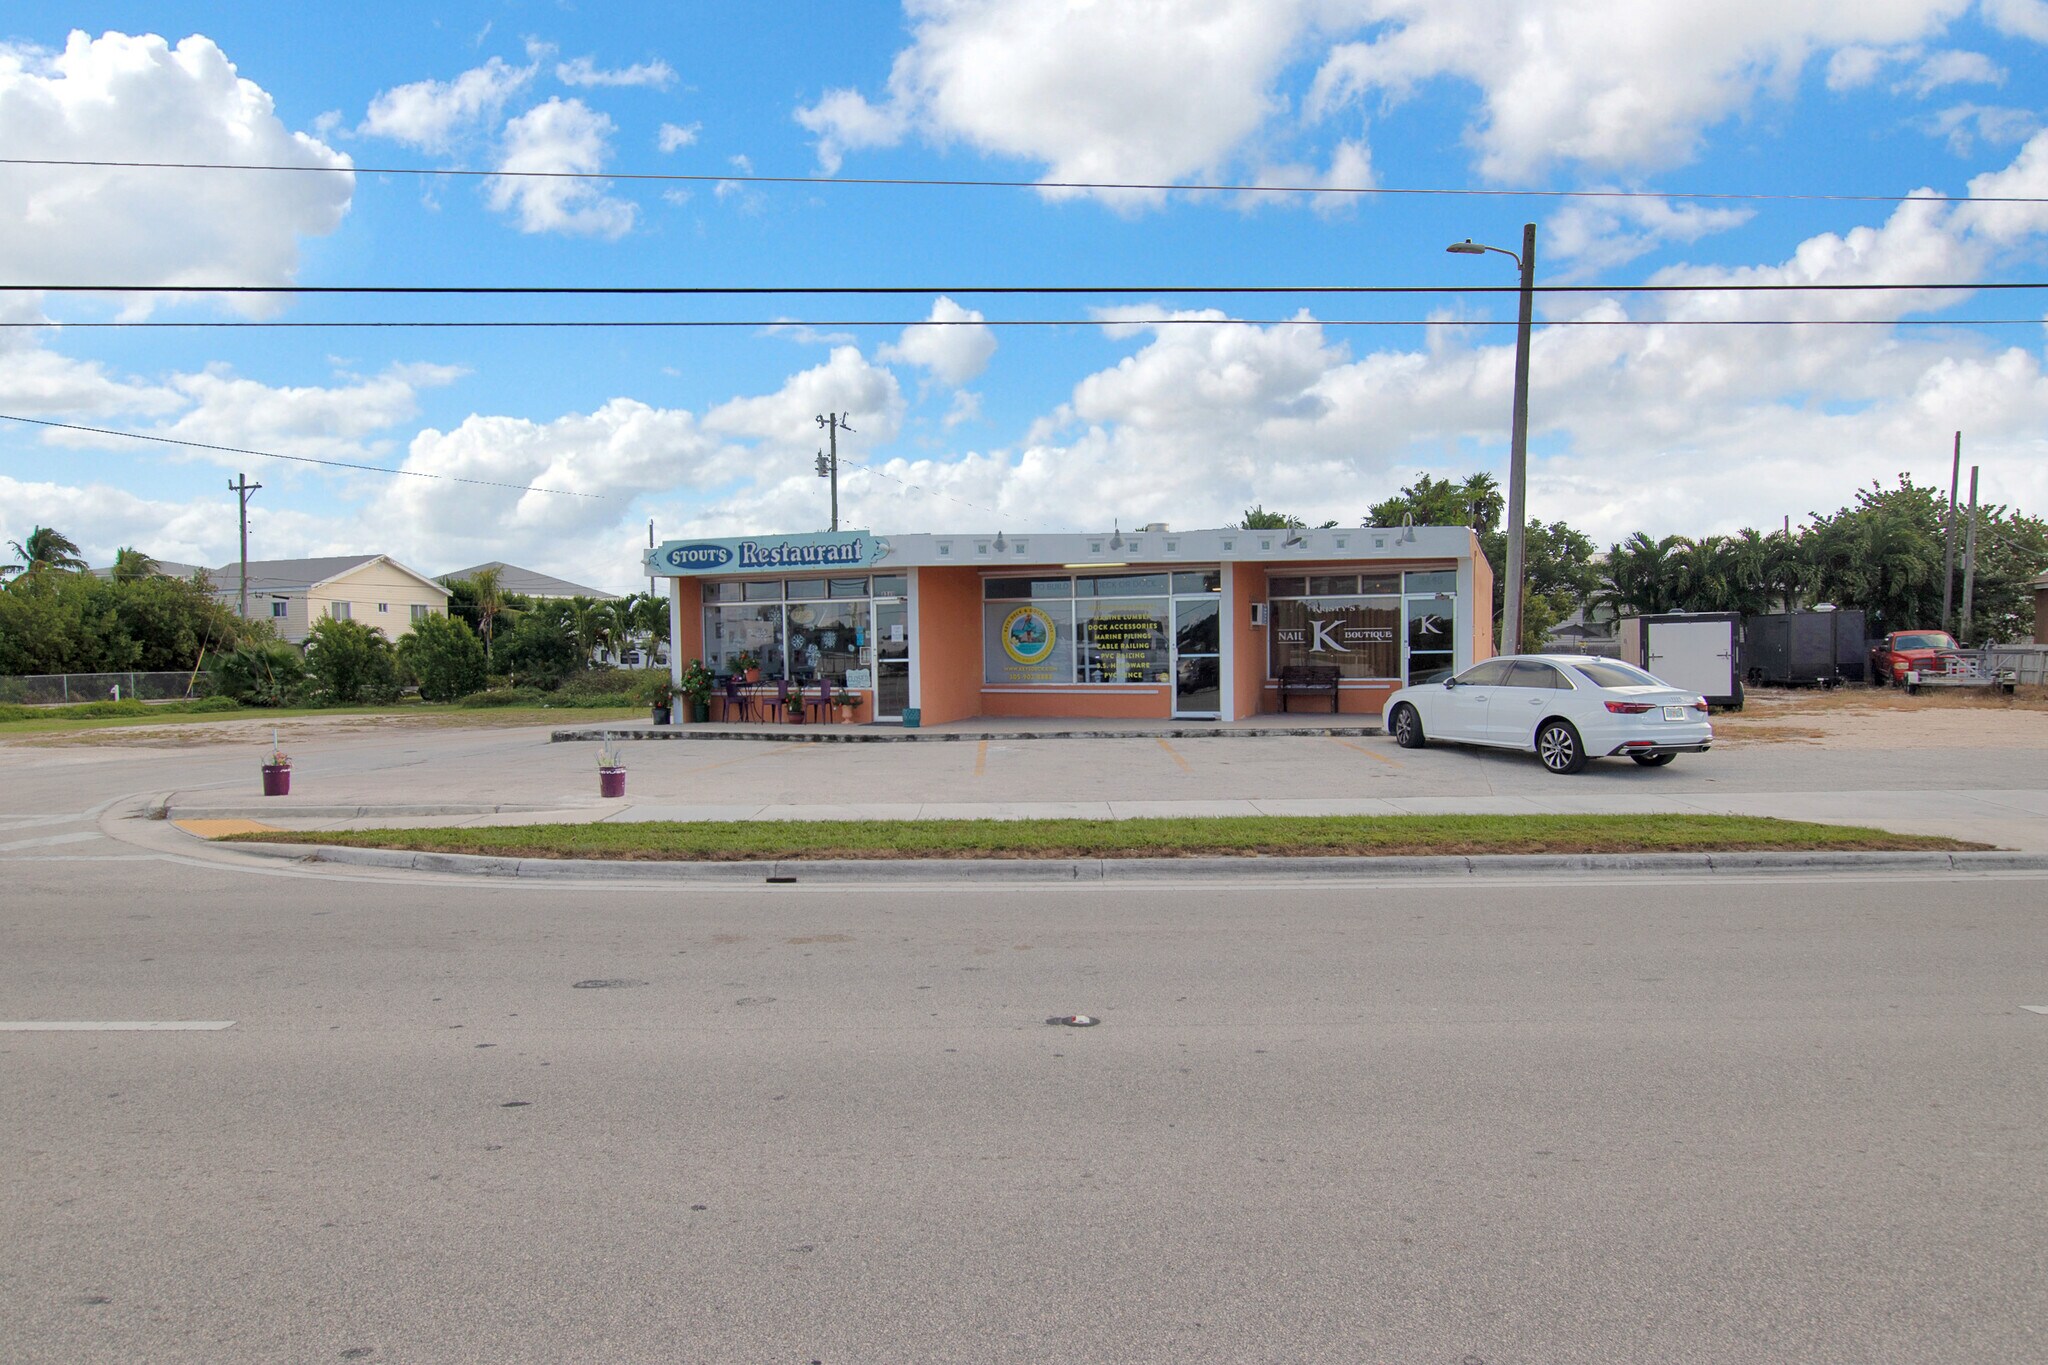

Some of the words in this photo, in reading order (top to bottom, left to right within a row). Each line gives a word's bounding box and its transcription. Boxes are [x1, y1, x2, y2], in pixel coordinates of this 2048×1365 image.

[672, 549, 727, 565] STOUT'S
[740, 538, 863, 566] Restaurant
[1278, 631, 1304, 641] NAIL
[1308, 620, 1351, 652] K
[1344, 630, 1393, 641] BOUTIQUE
[1419, 615, 1443, 634] K
